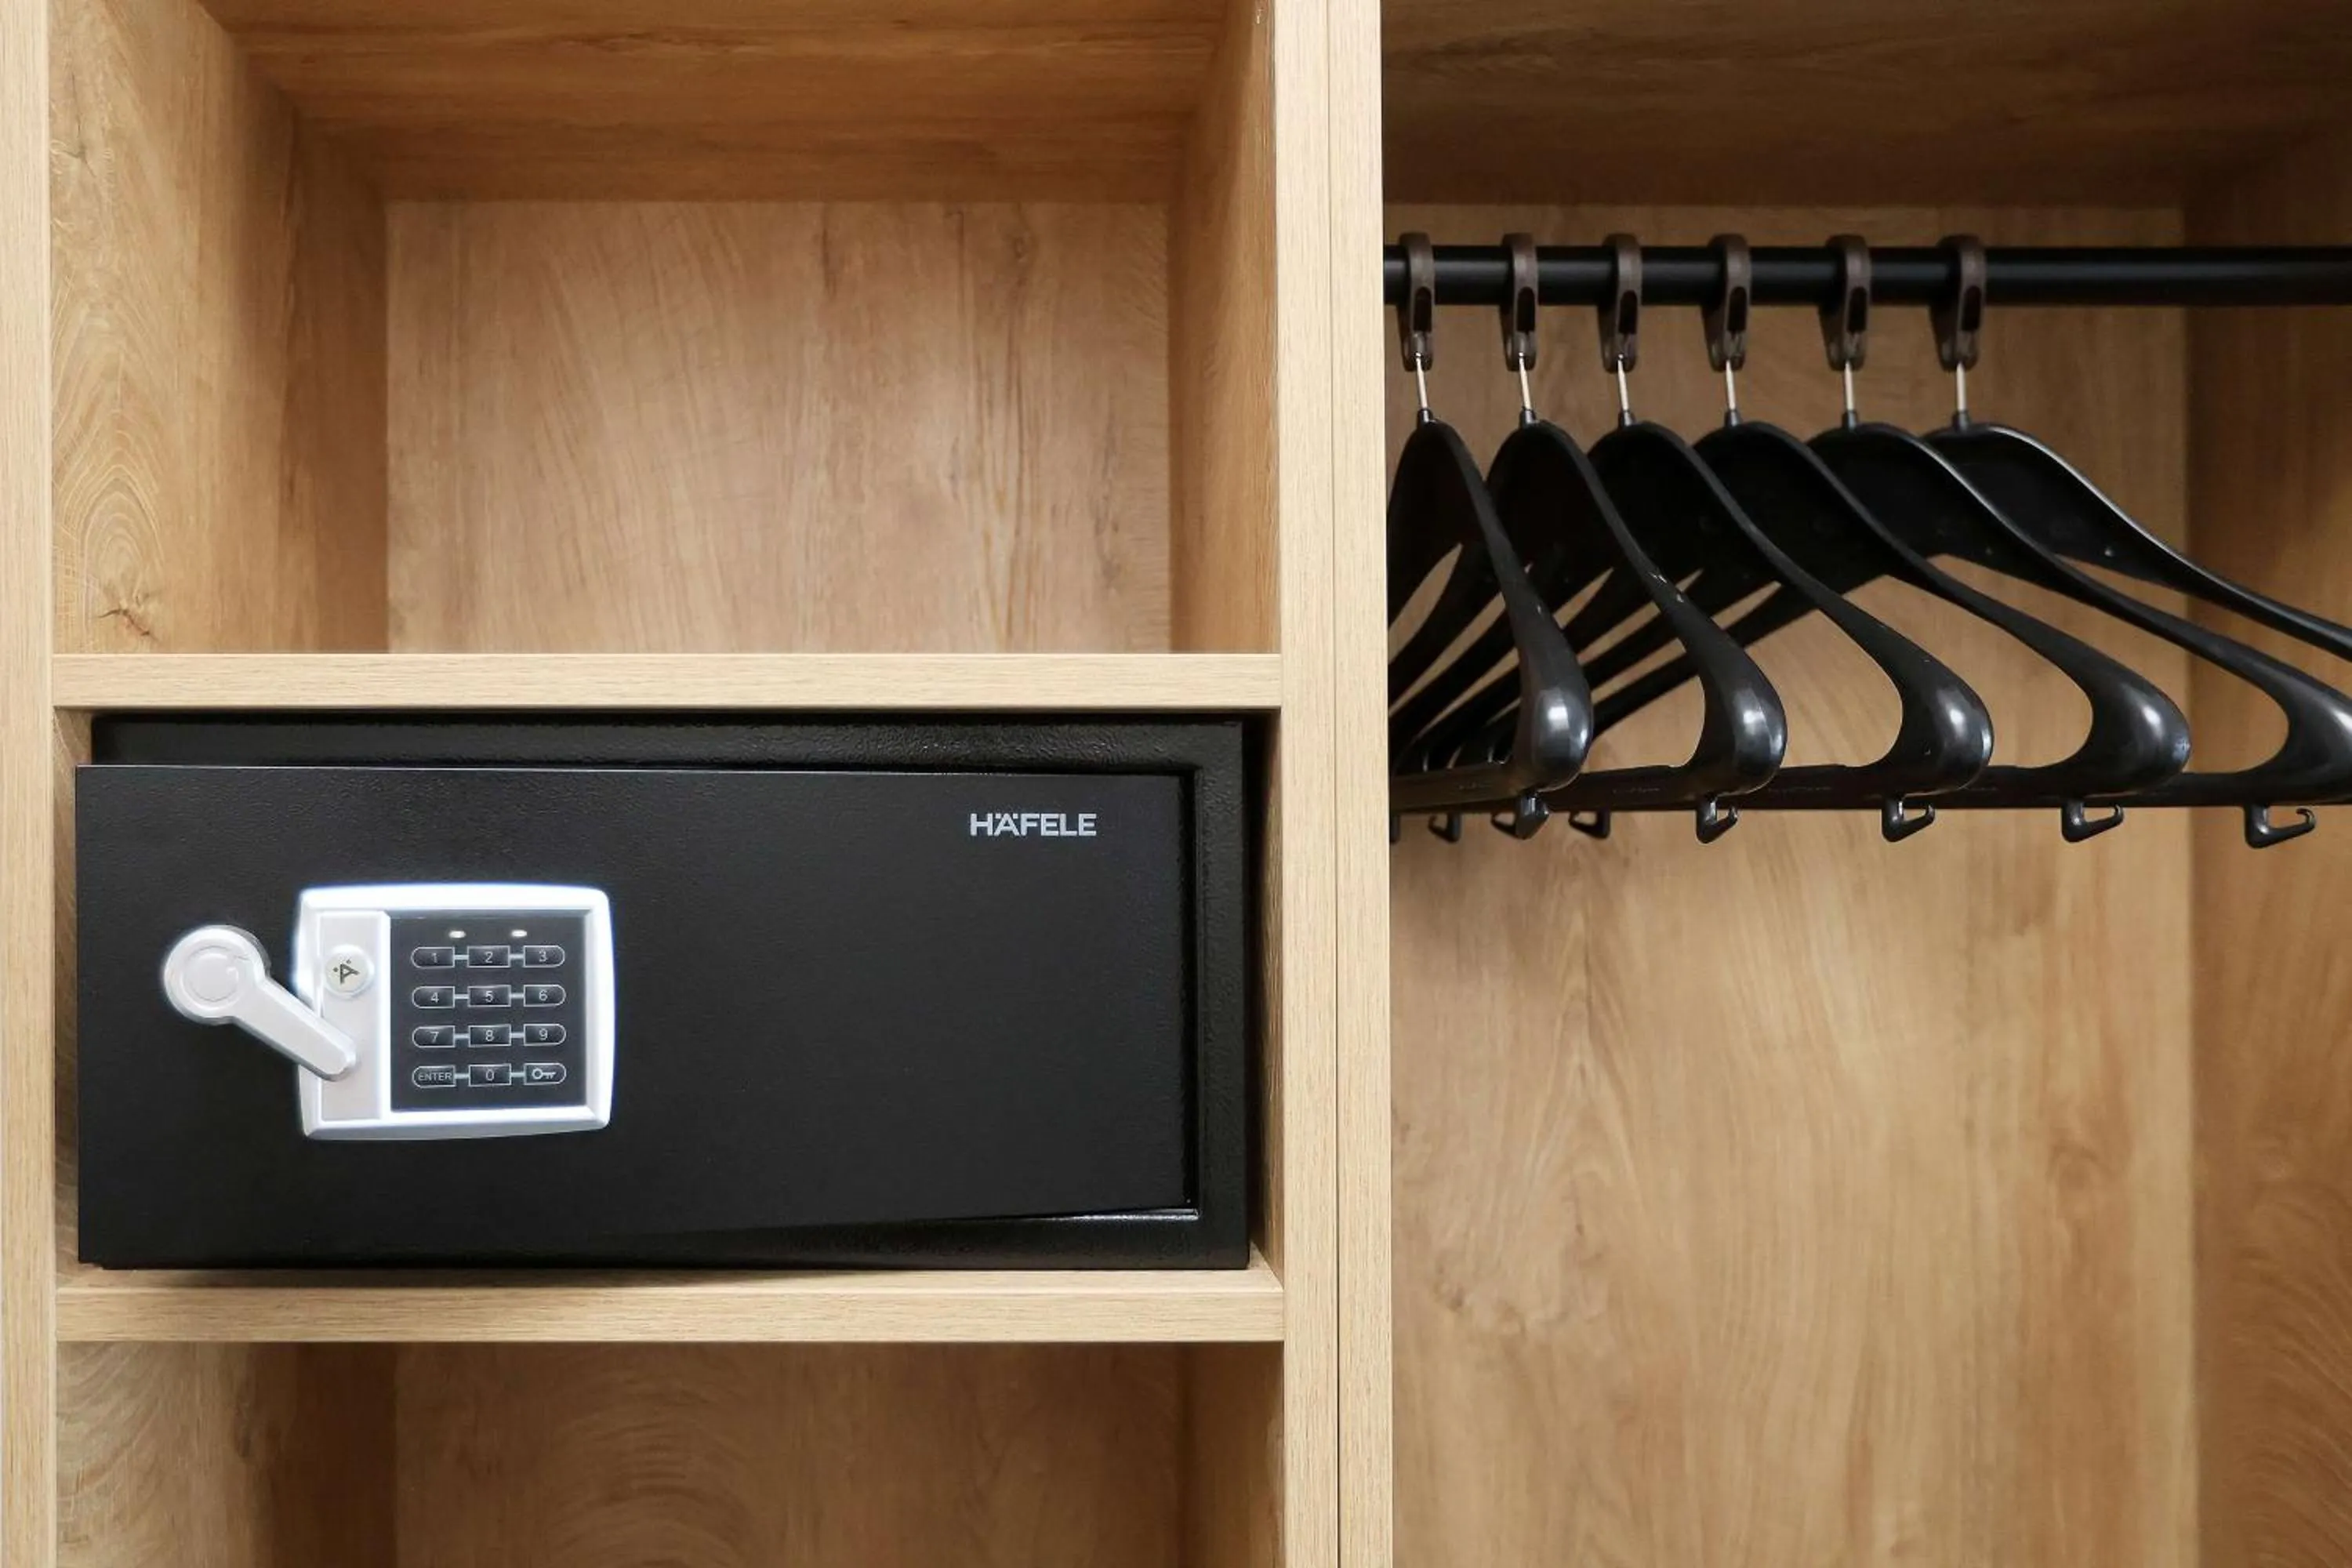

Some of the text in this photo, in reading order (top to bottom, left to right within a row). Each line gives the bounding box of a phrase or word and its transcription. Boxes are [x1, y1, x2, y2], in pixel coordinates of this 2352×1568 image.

[969, 812, 1097, 837] HÄFELE
[432, 949, 548, 964] 1 2 3
[430, 989, 548, 1003] 4 5 6
[430, 1028, 548, 1043] 7 8 9
[417, 1069, 495, 1081] ENTER 0
